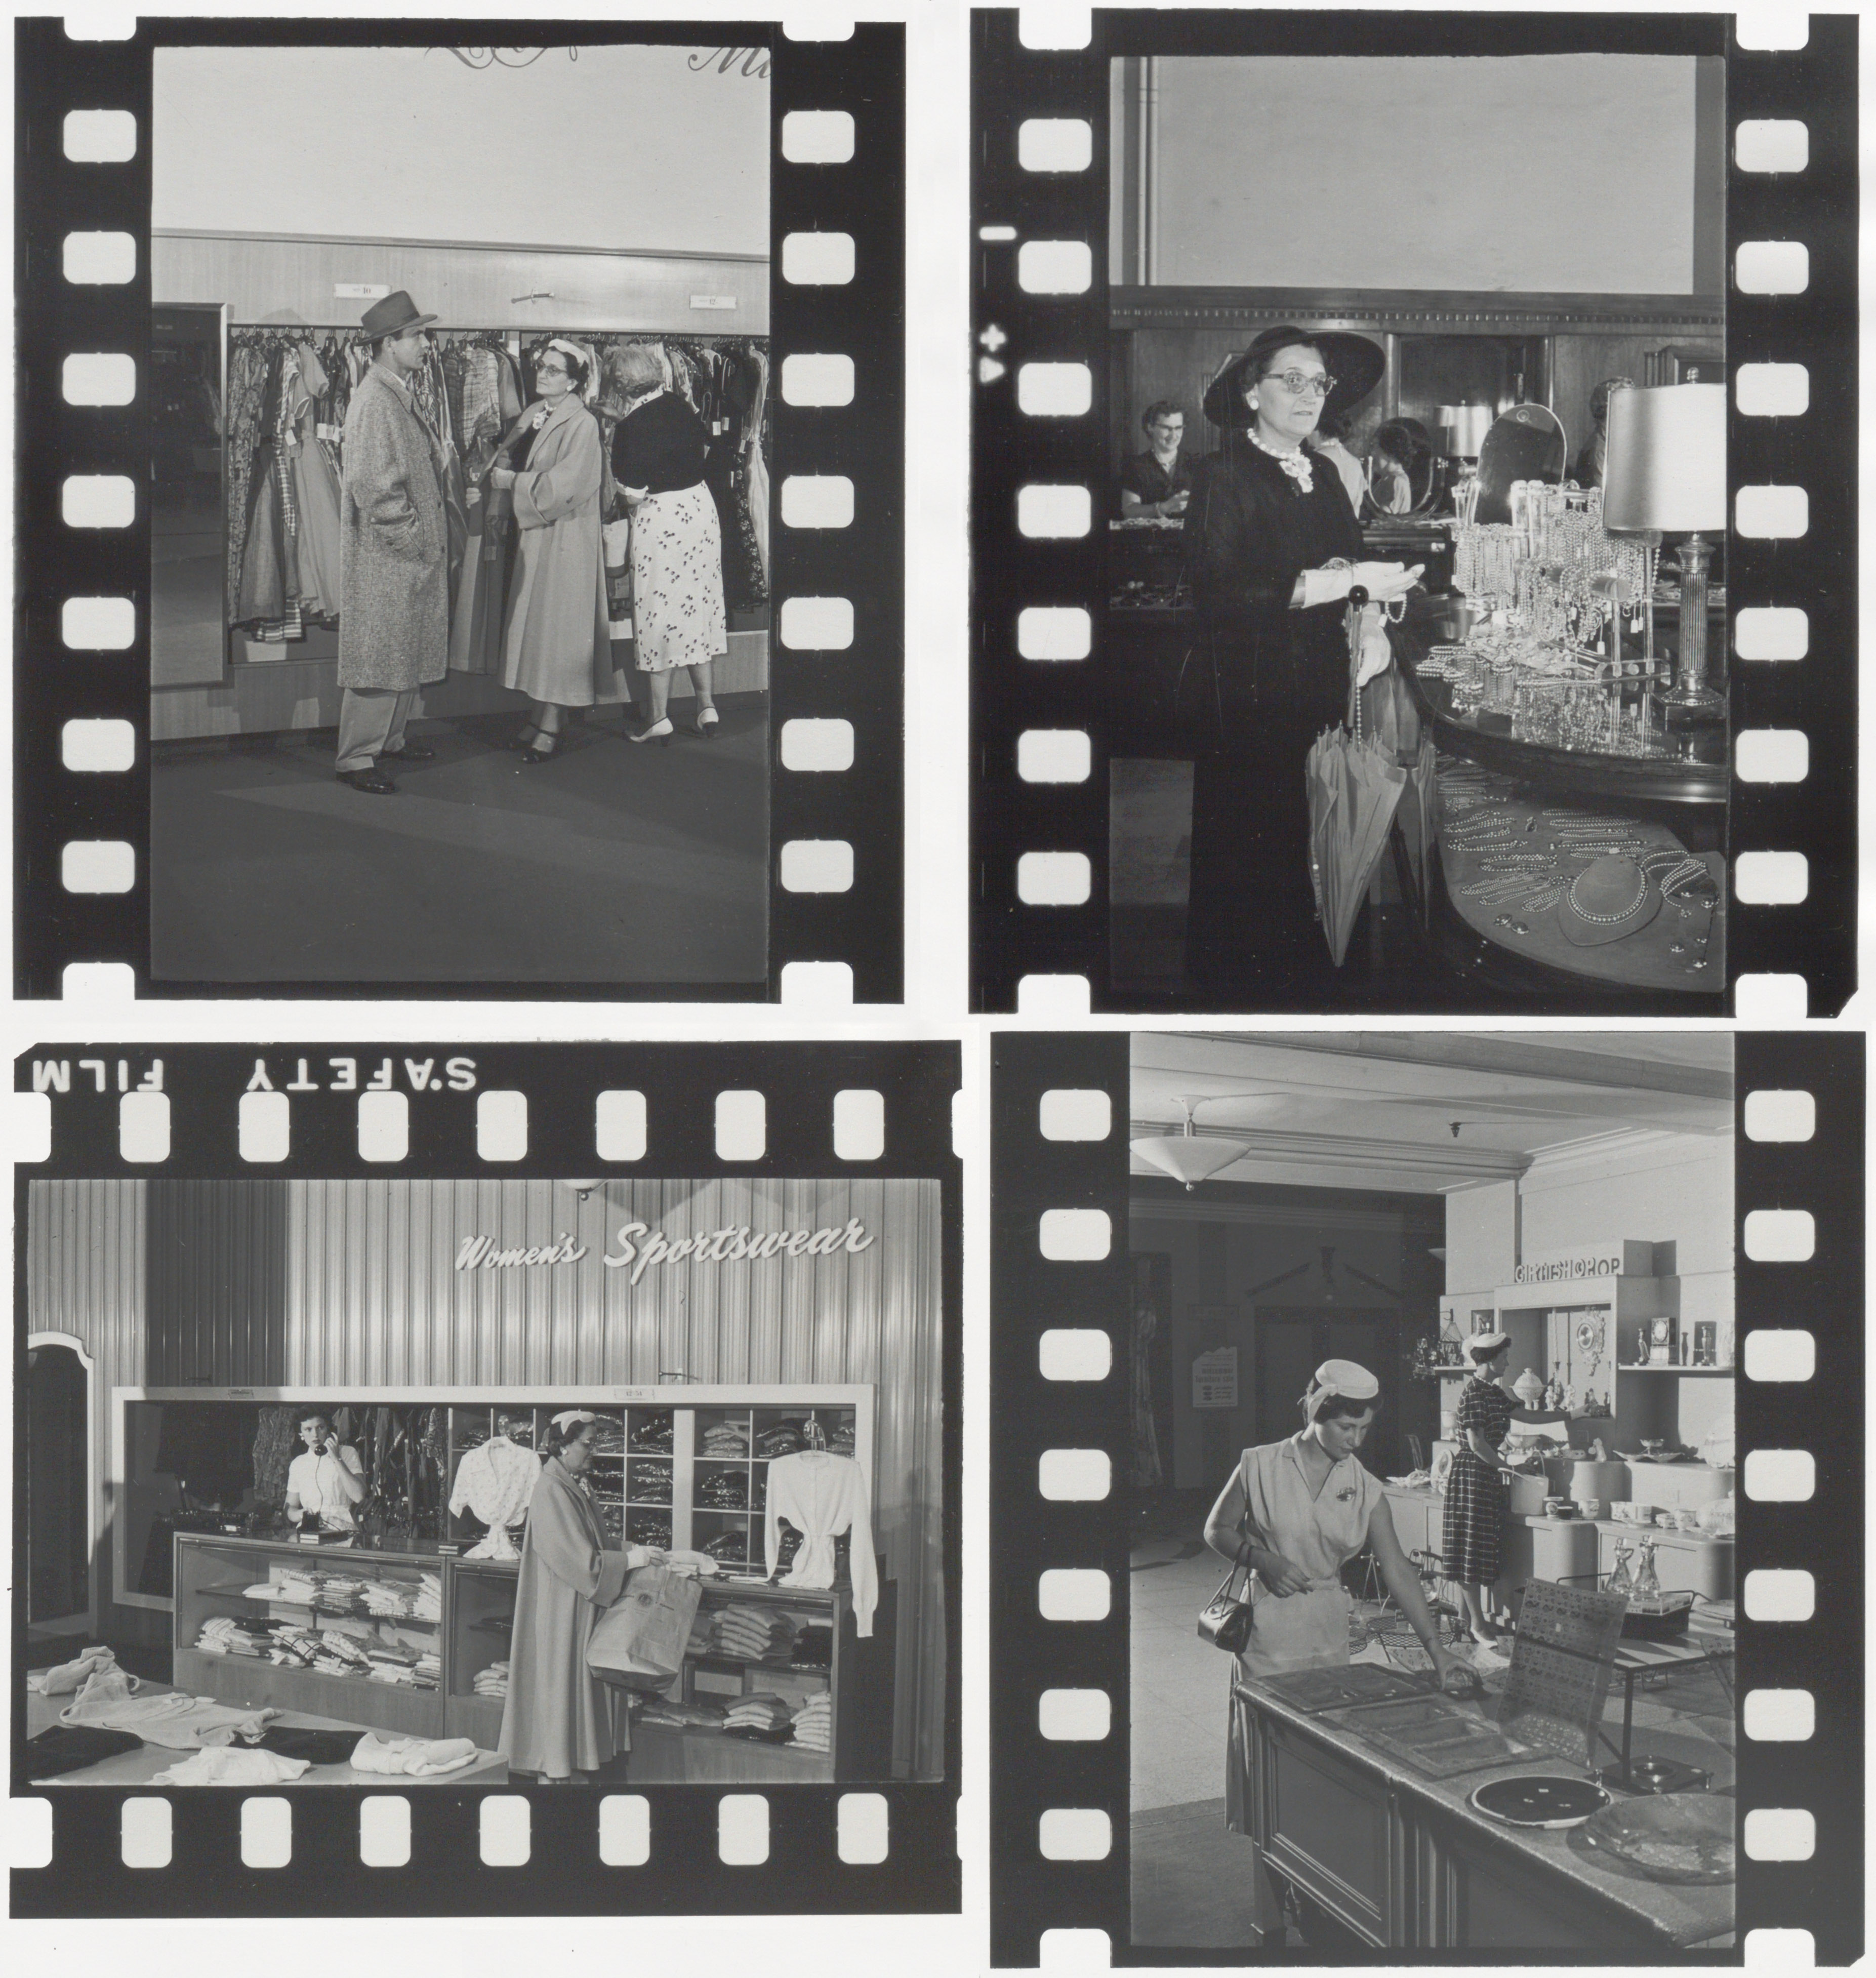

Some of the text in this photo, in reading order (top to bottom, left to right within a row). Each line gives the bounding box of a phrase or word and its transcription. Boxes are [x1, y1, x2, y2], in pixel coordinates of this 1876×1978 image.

[32, 1057, 477, 1092] SAFETY FILM
[455, 1218, 874, 1285] Women's Sportswear
